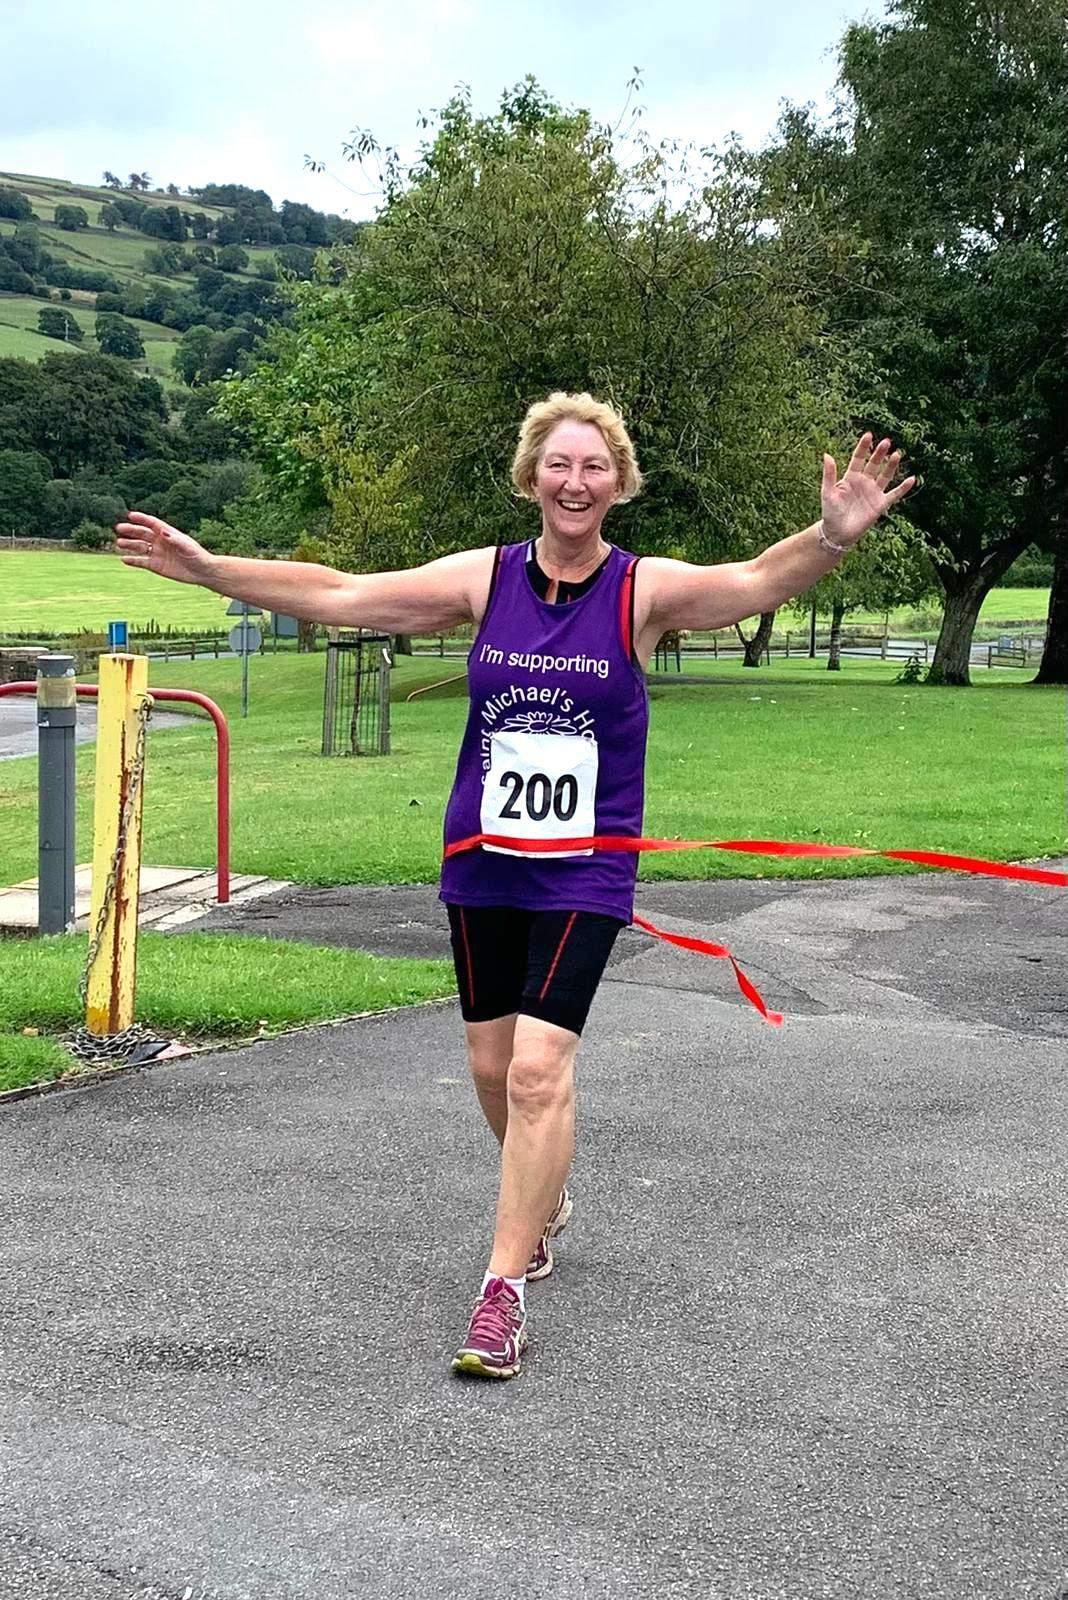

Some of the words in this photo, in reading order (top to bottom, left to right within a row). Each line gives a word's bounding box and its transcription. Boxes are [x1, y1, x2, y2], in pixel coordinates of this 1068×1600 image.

[479, 644, 504, 665] I'm
[507, 652, 609, 678] supporting
[481, 685, 574, 726] Michael's
[498, 770, 579, 822] 200
